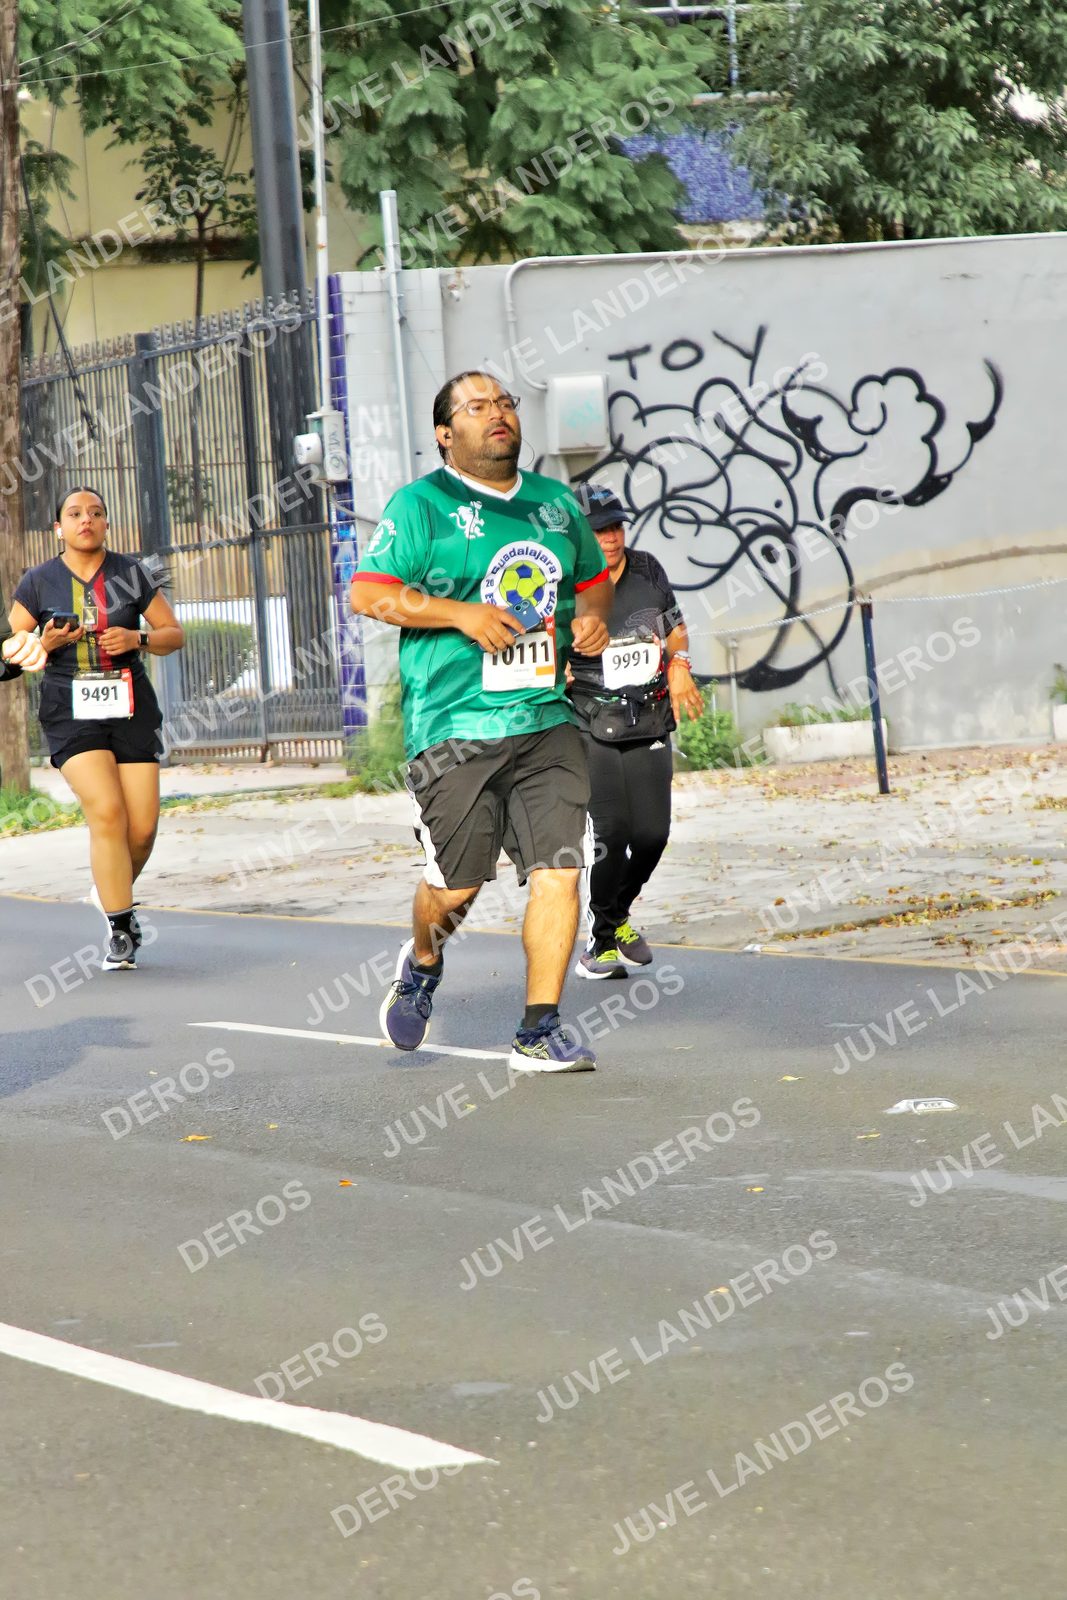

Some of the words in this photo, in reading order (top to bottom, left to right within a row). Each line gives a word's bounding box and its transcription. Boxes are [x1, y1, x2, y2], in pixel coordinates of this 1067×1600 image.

[608, 324, 768, 388] TOY
[491, 547, 557, 574] Guadalajara
[492, 640, 550, 666] 10111
[612, 649, 649, 670] 9991
[82, 686, 118, 701] 9491
